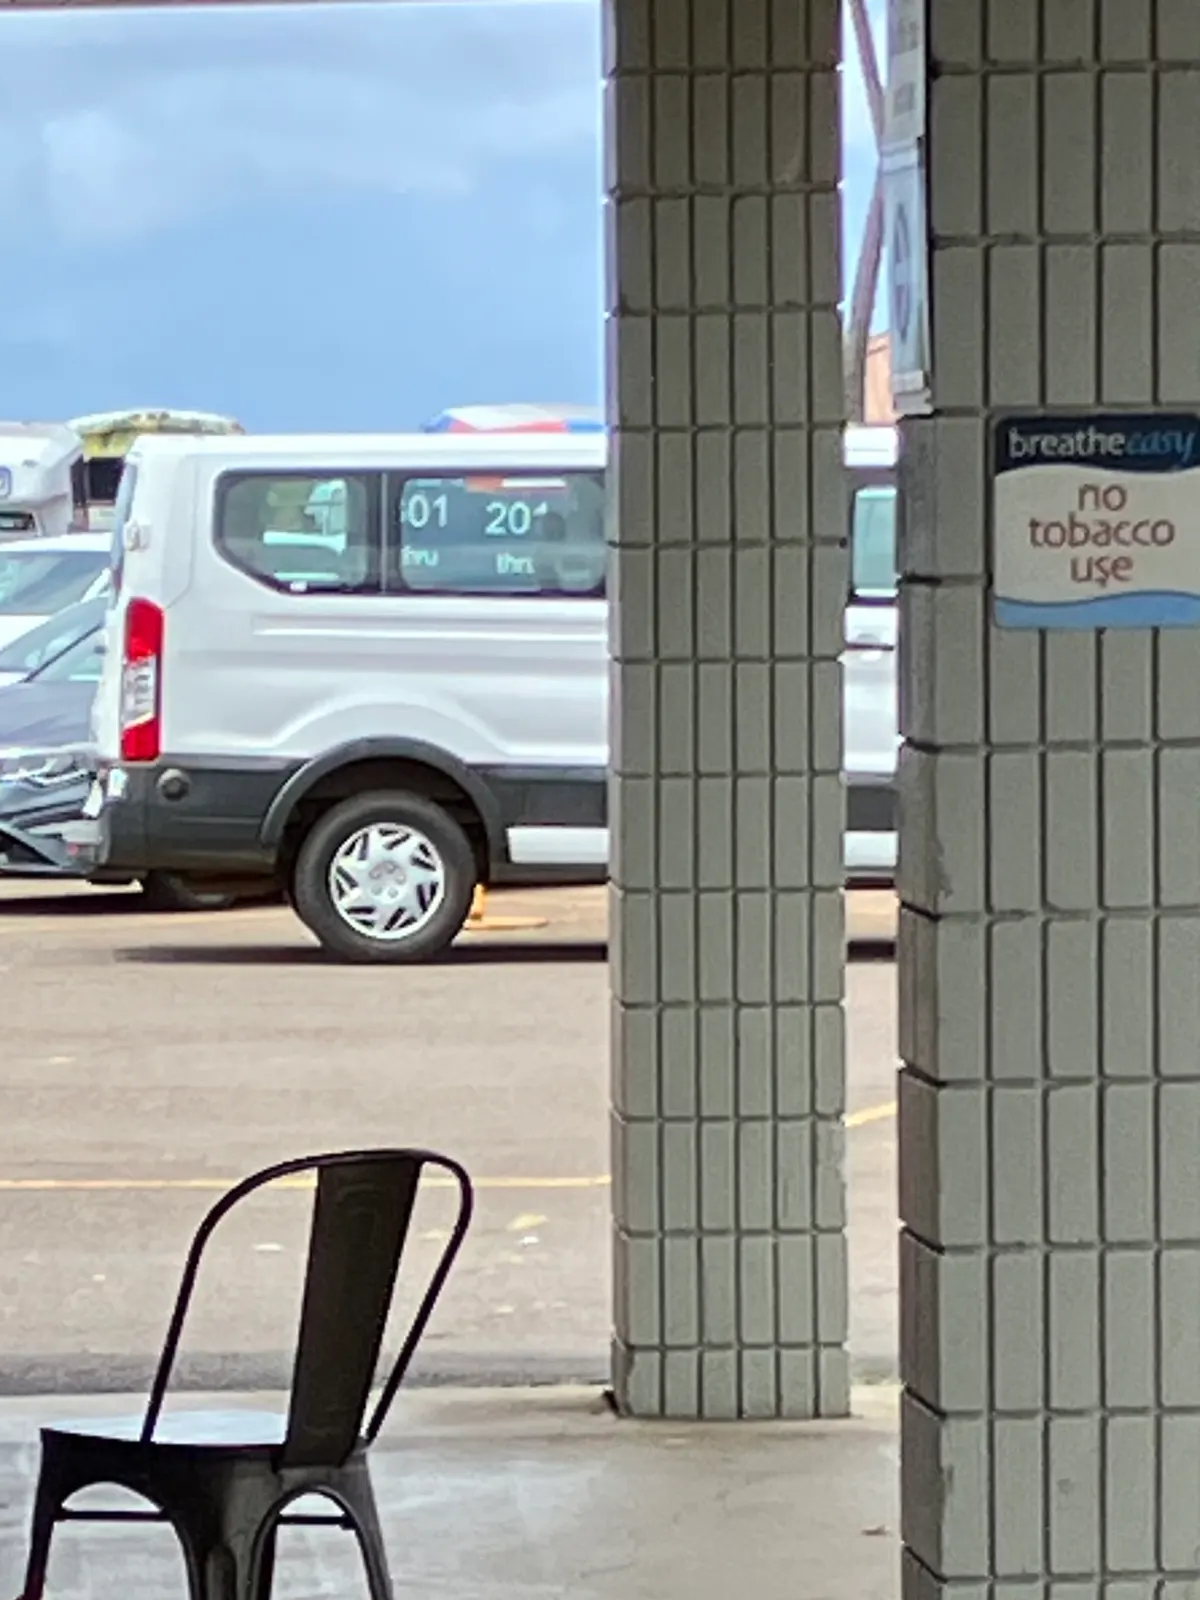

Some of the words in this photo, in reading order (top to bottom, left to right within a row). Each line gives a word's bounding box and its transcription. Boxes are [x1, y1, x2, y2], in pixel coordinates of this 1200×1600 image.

[1078, 484, 1128, 512] no
[1029, 512, 1175, 548] tobacco
[1070, 555, 1134, 587] use
